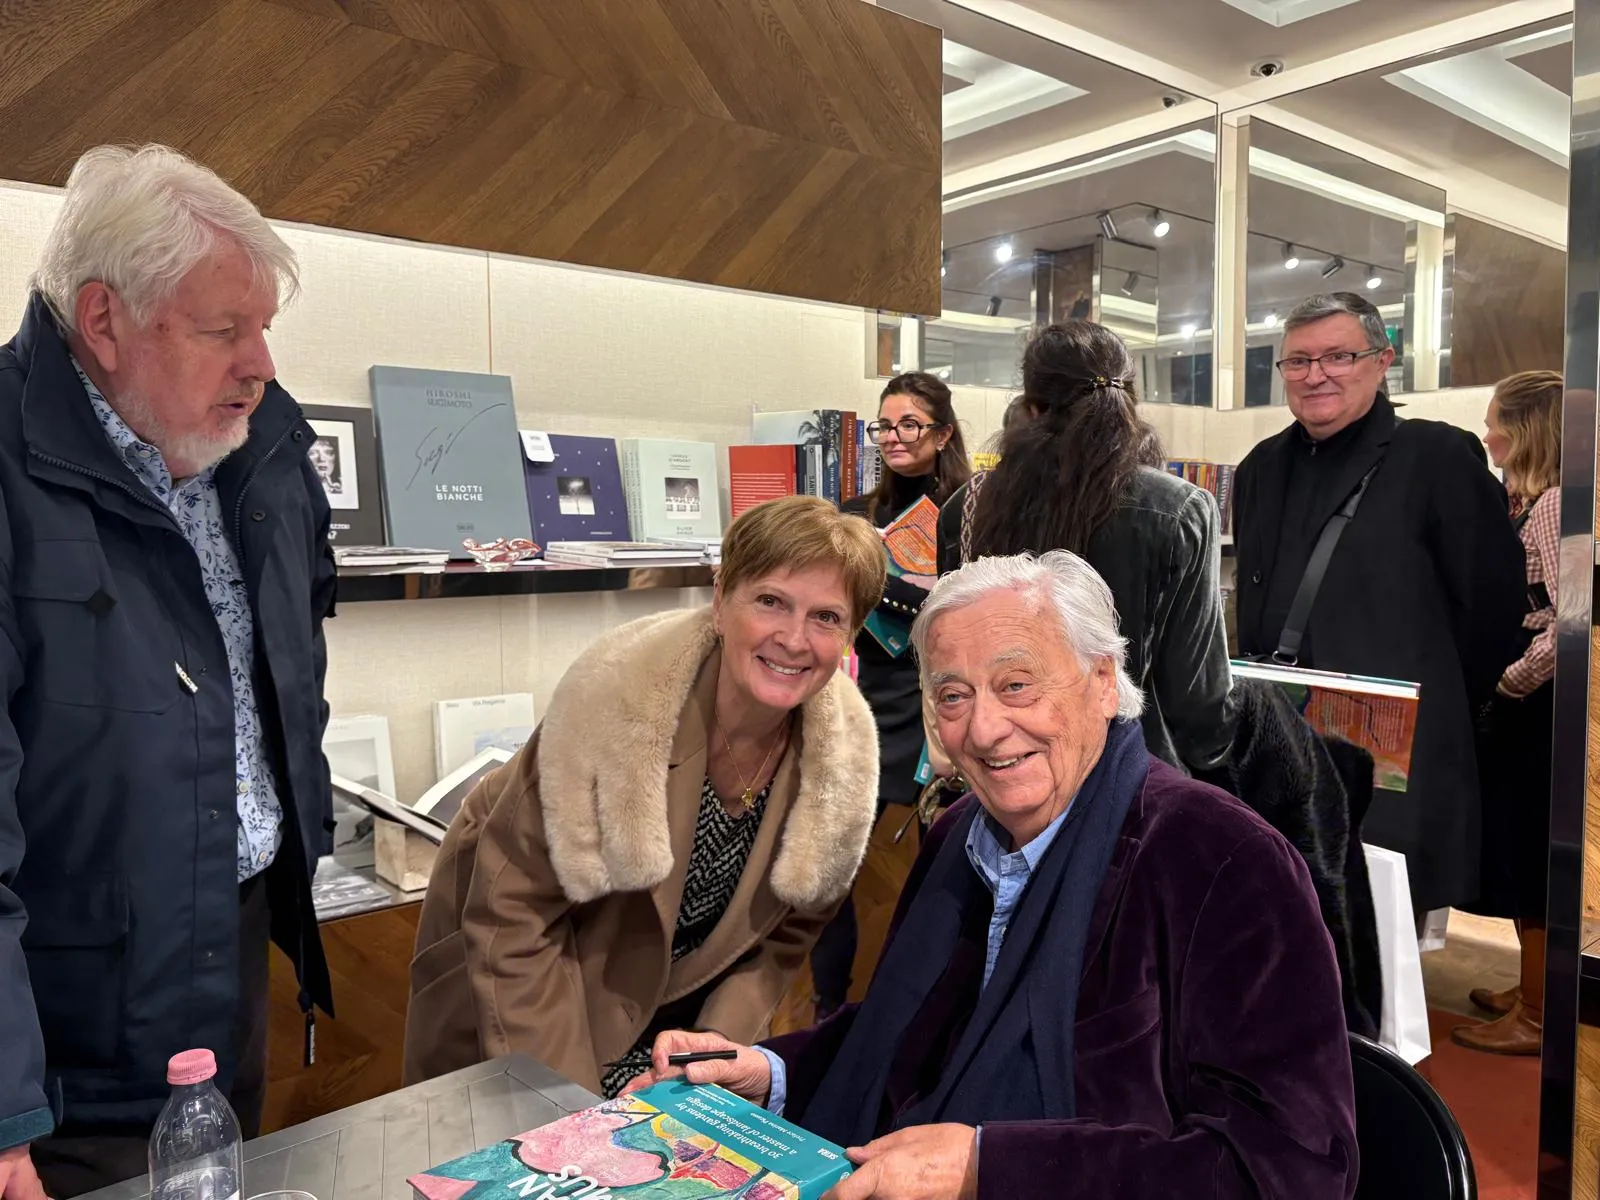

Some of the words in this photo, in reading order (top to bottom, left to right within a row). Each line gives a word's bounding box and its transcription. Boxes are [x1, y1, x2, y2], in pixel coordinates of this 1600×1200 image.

[435, 484, 449, 493] LE
[451, 485, 483, 494] NOTTI
[436, 493, 484, 502] BIANCHE
[675, 1102, 688, 1113] by
[686, 1096, 711, 1113] design
[686, 1107, 720, 1126] gardens
[709, 1108, 750, 1132] landscape
[718, 1122, 769, 1156] breathtaking
[757, 1132, 790, 1152] master
[768, 1150, 784, 1161] 30
[788, 1148, 798, 1156] a
